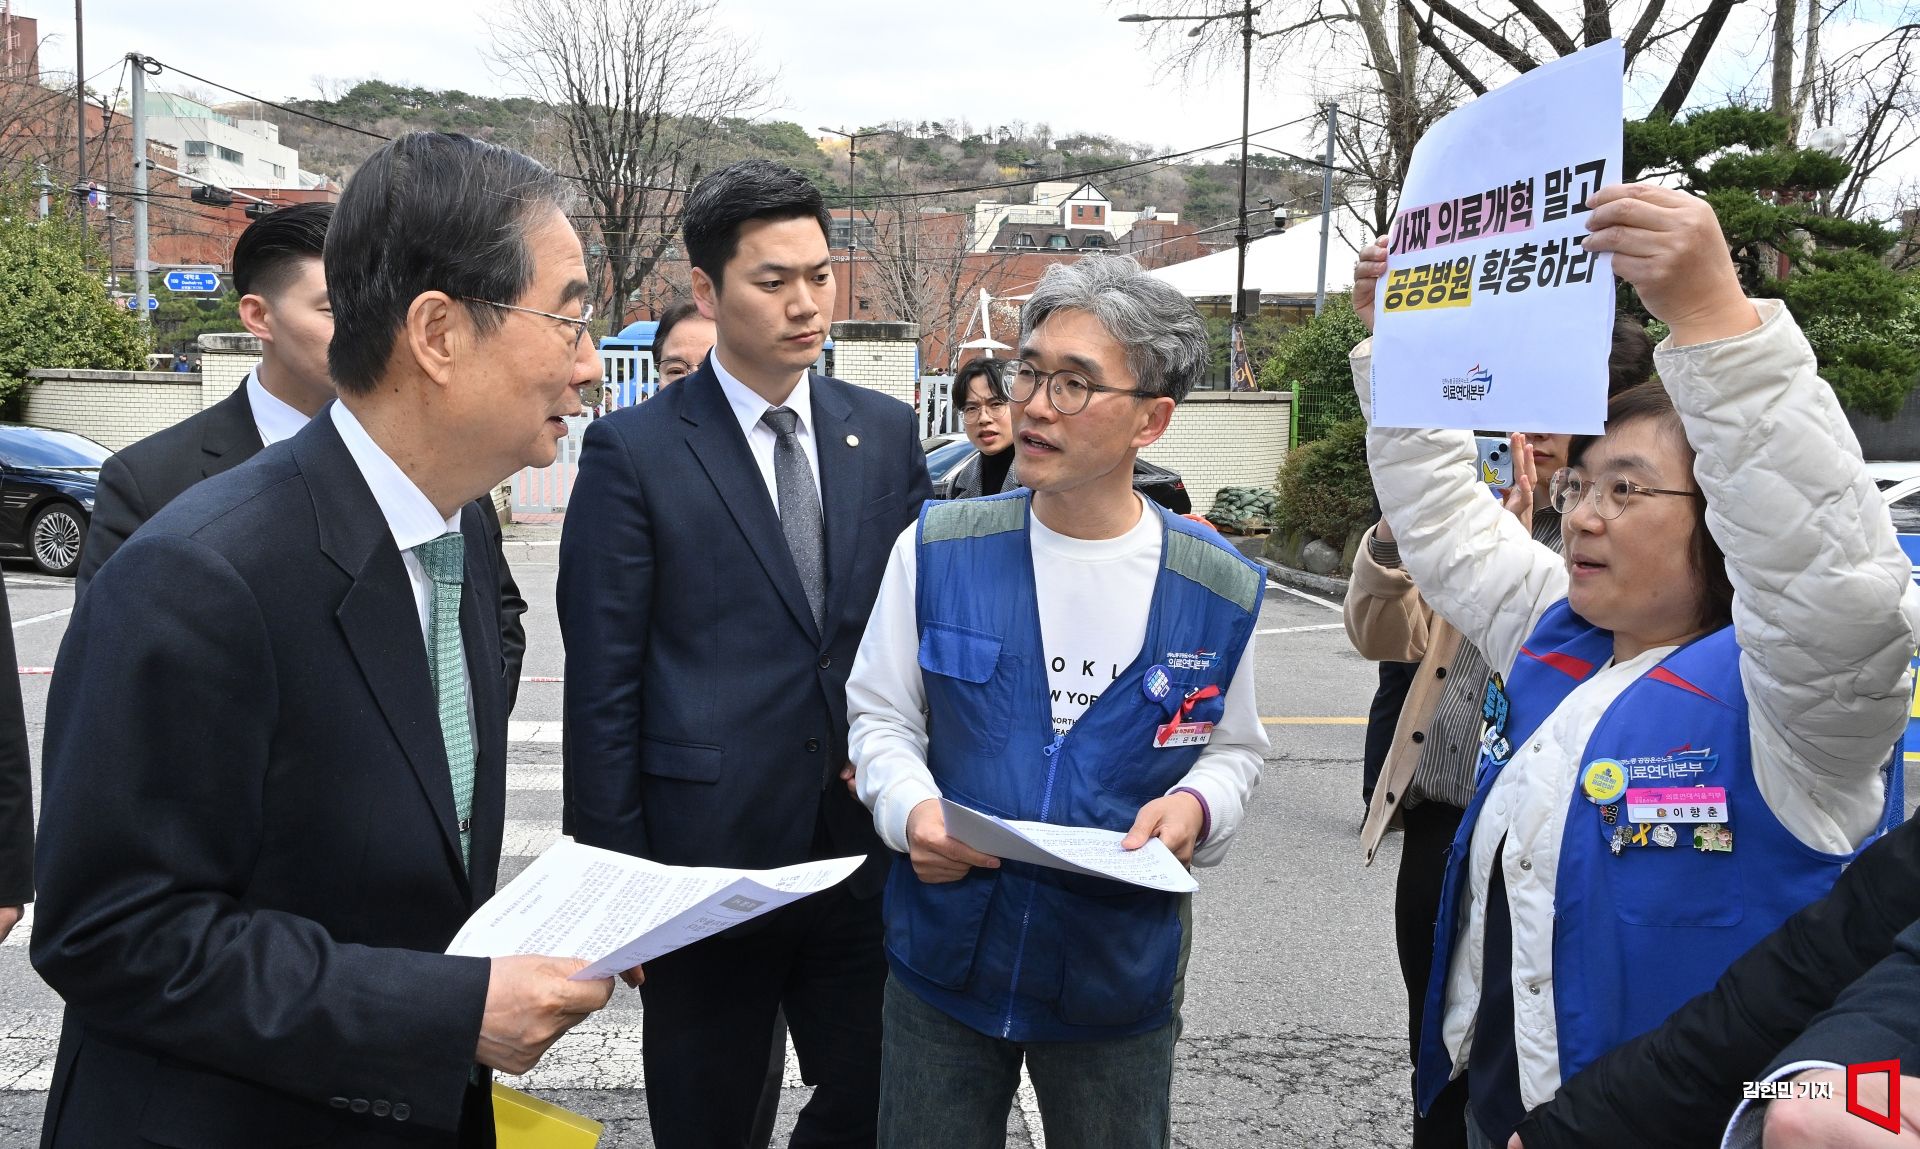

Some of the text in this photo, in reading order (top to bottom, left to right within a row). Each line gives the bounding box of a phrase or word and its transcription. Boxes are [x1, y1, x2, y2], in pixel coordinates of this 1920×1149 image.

[1390, 159, 1606, 255] 가짜 의료개혁 말고
[1385, 234, 1601, 310] 공공병원 확충하라
[1442, 384, 1485, 401] 의료연대본부
[1051, 656, 1118, 680] OKL
[1050, 689, 1099, 706] W YOR
